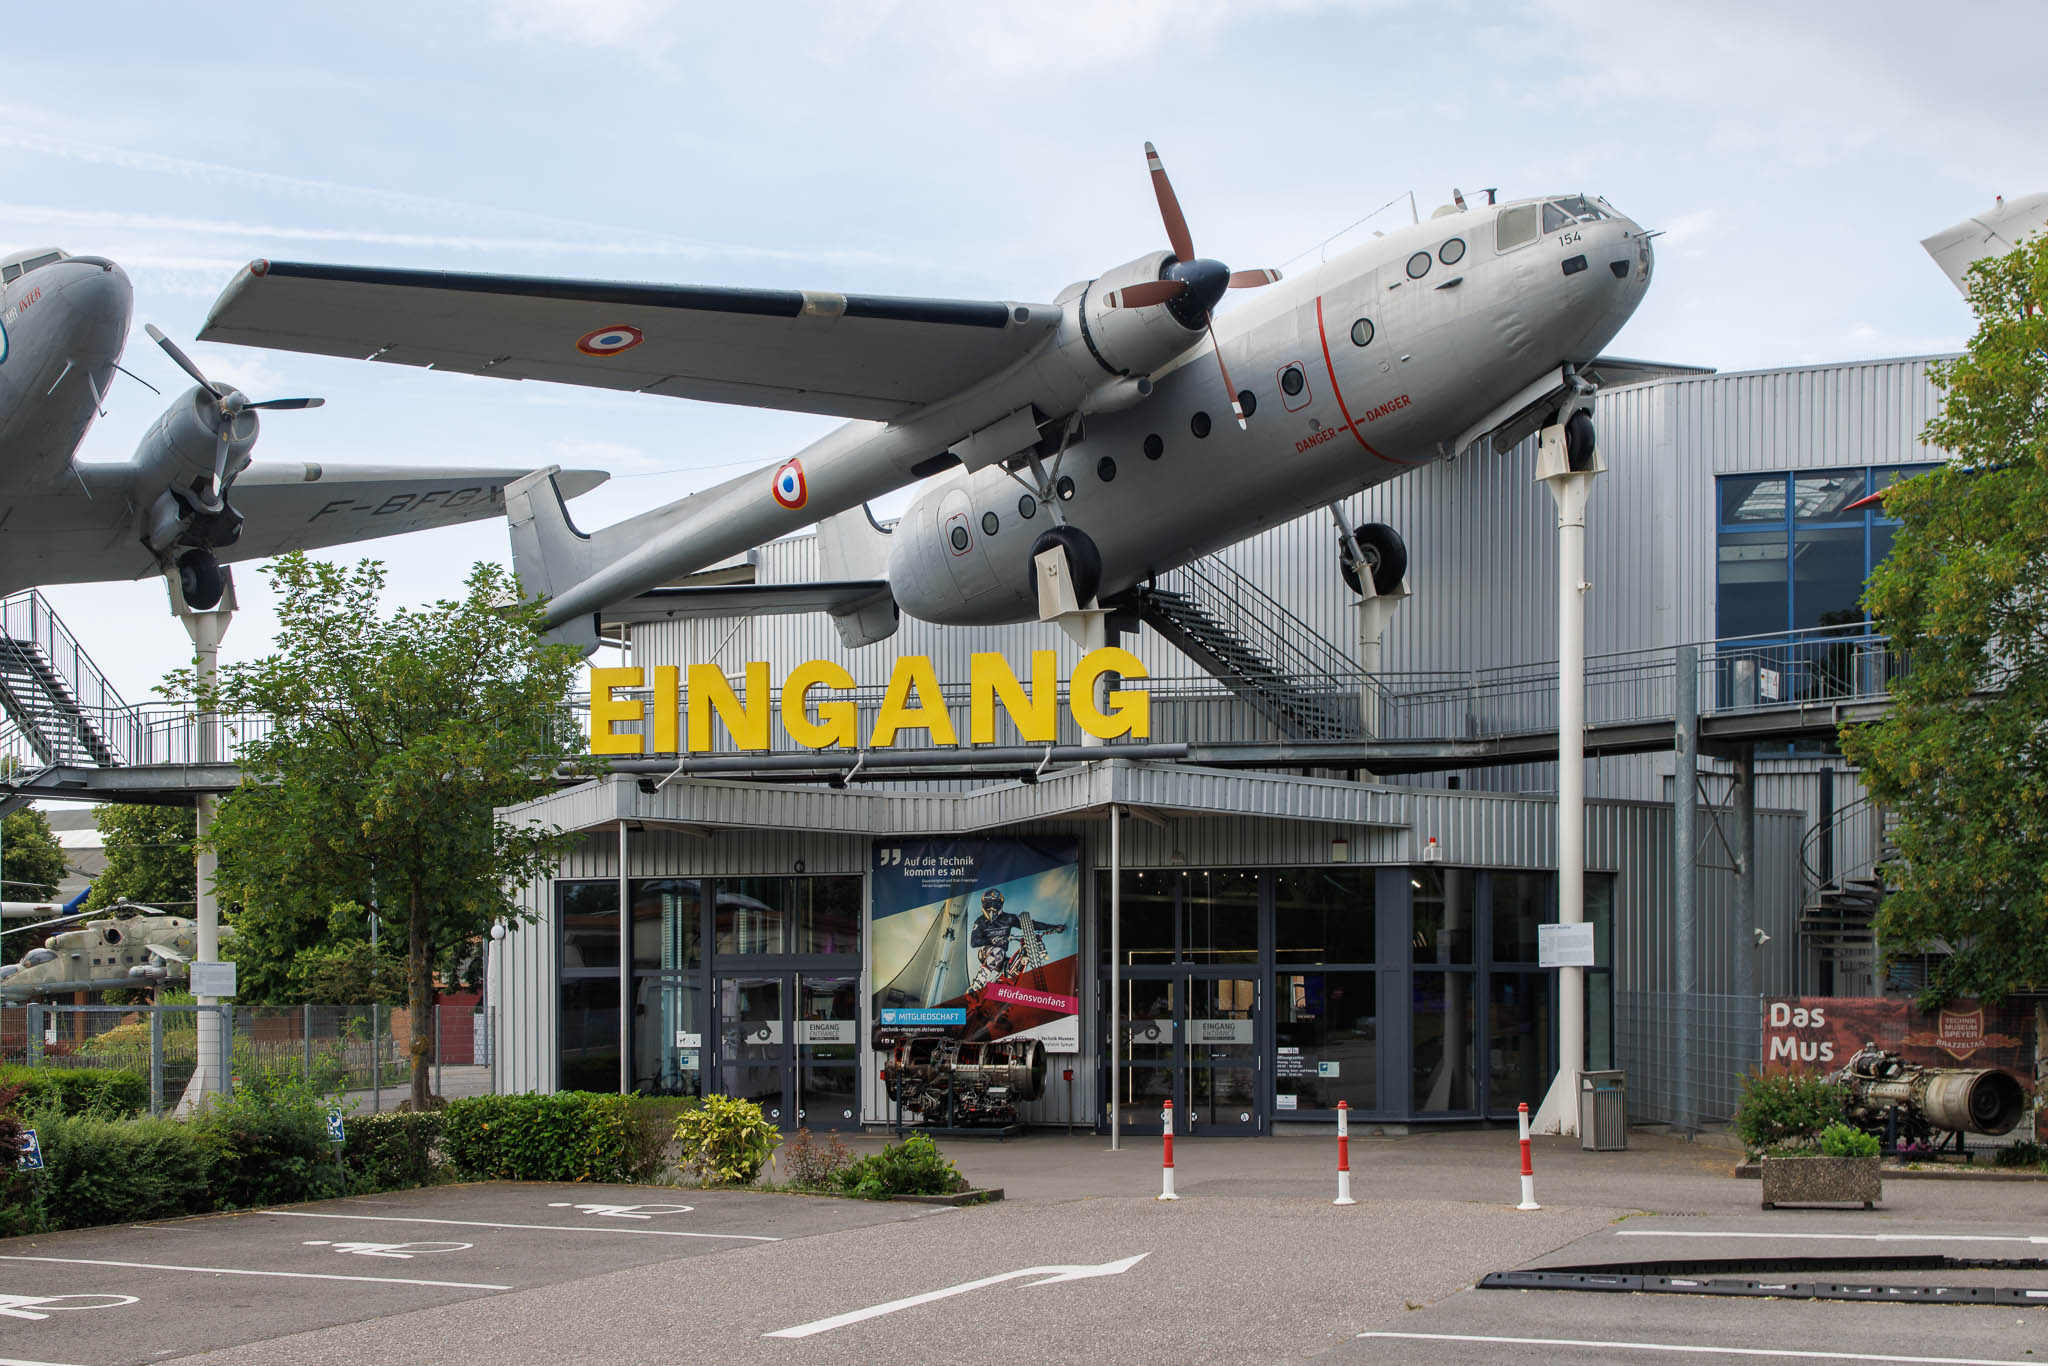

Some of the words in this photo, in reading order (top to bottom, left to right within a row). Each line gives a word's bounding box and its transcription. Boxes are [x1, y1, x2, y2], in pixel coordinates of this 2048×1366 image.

[1559, 231, 1582, 247] 154
[5, 306, 18, 324] AIR
[18, 287, 41, 313] INTER
[1366, 394, 1411, 422] DANGER
[1295, 427, 1337, 454] DANGER
[590, 647, 1150, 756] EINGANG
[904, 857, 920, 866] Auf
[922, 856, 936, 866] die
[939, 856, 974, 866] Technik
[904, 867, 935, 877] kommt
[950, 867, 964, 876] an!
[997, 988, 1066, 1008] #fürfansvonfans
[898, 1012, 959, 1021] MITGLIEDSCHAFT
[1770, 1002, 1825, 1028] Das
[809, 1023, 839, 1031] EINGANG
[1769, 1036, 1834, 1062] Mus
[1936, 1039, 1985, 1048] BRAZZELTAG
